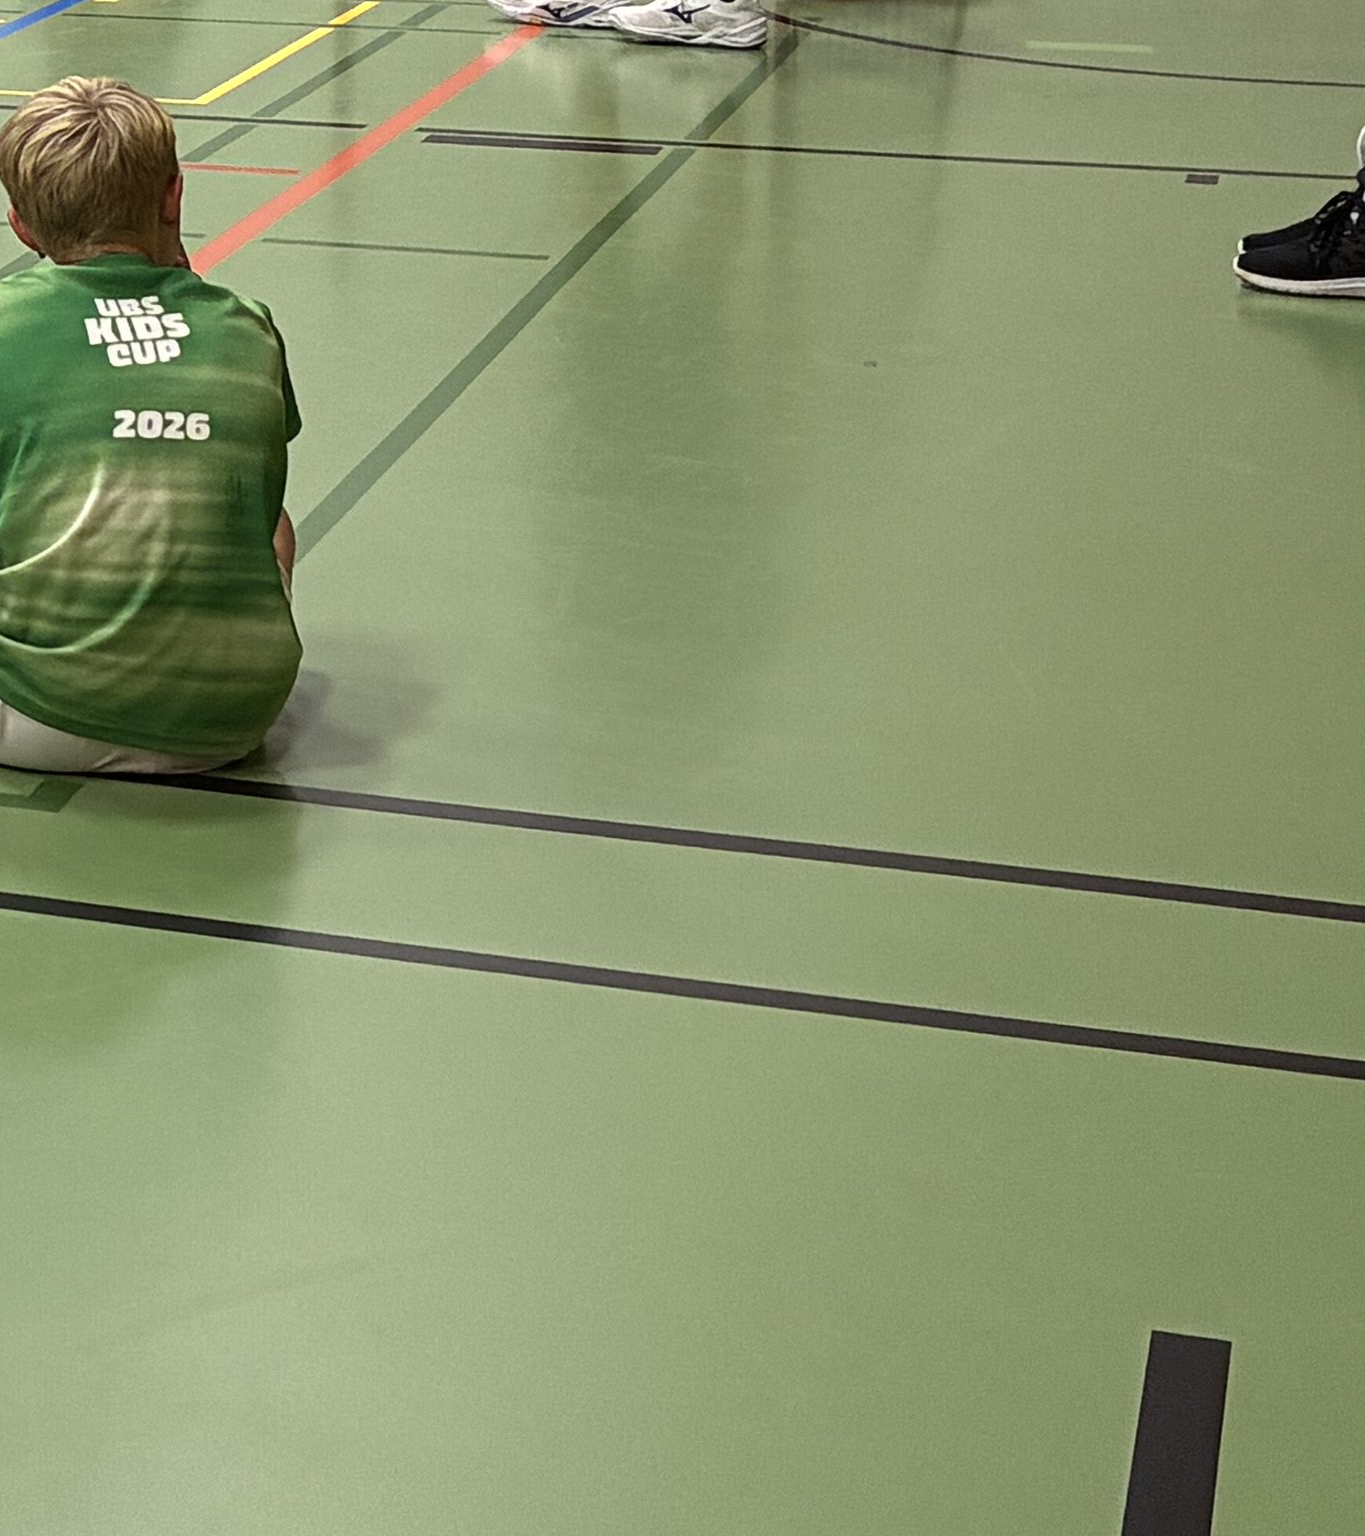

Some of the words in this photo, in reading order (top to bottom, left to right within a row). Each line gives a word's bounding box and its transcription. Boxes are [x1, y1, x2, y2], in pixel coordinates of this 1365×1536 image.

[94, 296, 164, 316] UBS
[84, 312, 191, 345] KIDS
[106, 339, 181, 367] CUP
[112, 409, 211, 441] 2026
